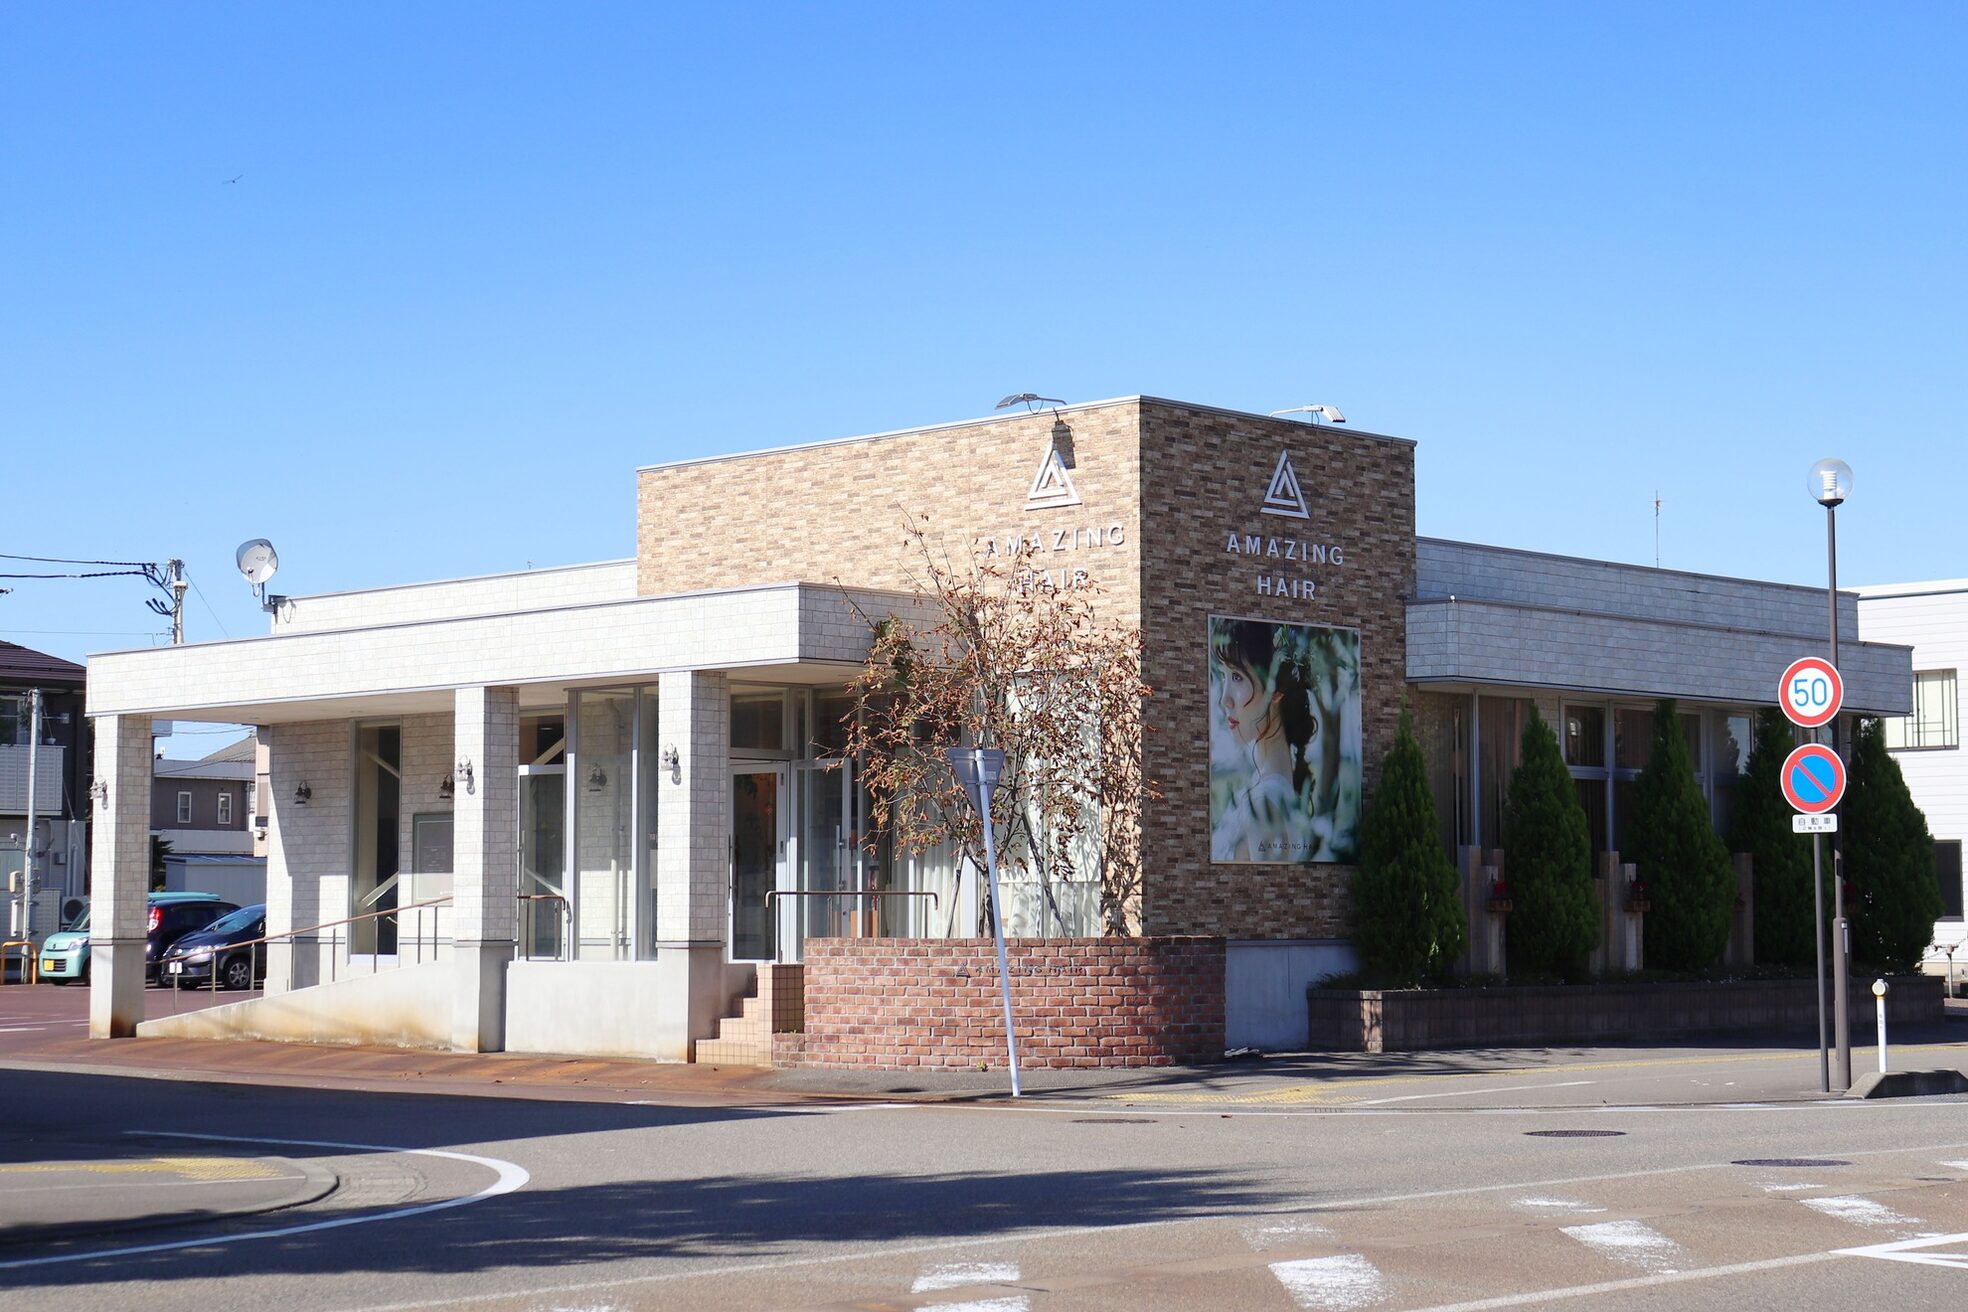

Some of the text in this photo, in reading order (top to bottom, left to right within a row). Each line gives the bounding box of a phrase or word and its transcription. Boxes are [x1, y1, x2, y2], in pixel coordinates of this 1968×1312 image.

[985, 523, 1125, 558] AMAZING
[1226, 533, 1344, 566] AMAZING
[1019, 567, 1089, 596] HAIR
[1257, 575, 1315, 601] HAIR
[1793, 678, 1827, 707] 50
